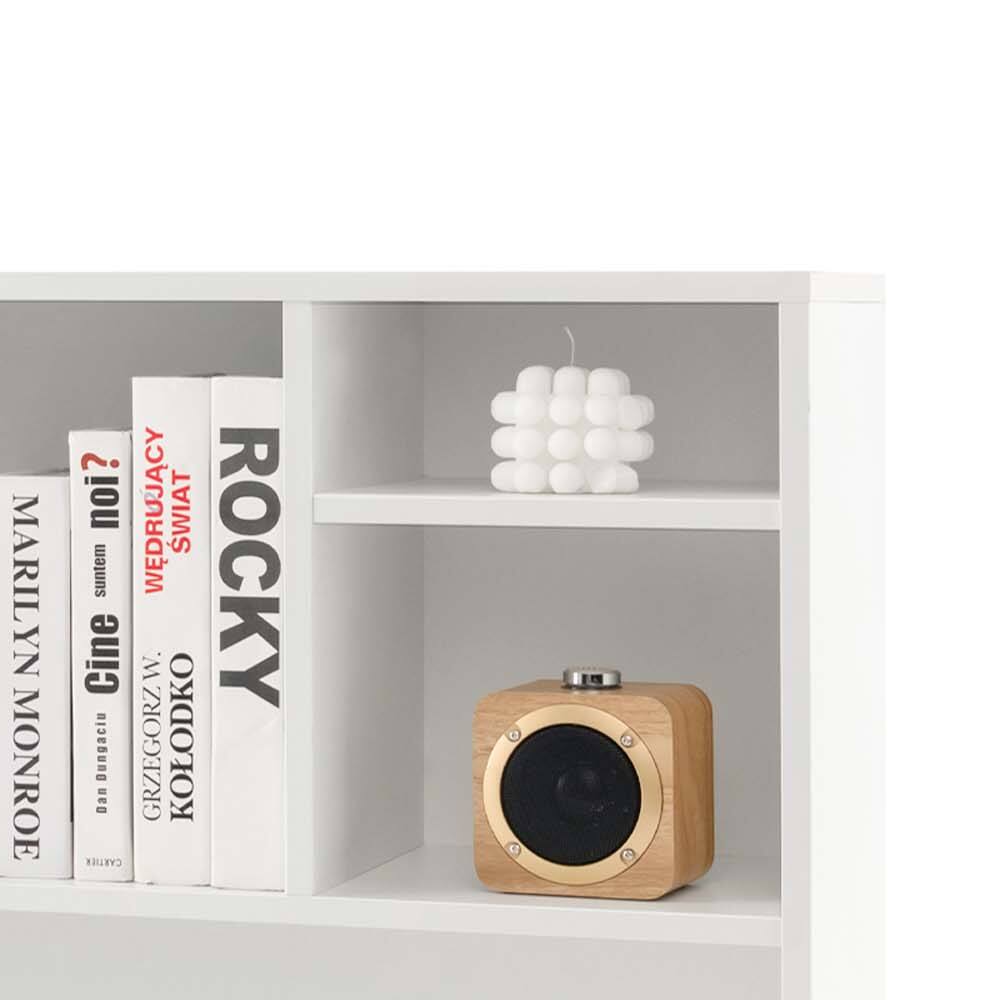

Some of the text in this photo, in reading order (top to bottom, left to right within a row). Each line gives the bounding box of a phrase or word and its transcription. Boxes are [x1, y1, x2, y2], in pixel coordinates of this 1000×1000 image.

[93, 544, 107, 598] suntem
[145, 426, 169, 594] WĘDRUJĄCY
[166, 469, 191, 554] ŚWIAT
[219, 427, 282, 709] ROCKY
[12, 495, 41, 861] MARILYN MONROE
[84, 614, 120, 694] Cine
[95, 712, 108, 814] Dan Dungaciu
[142, 652, 162, 822] GRZEGORZ W.
[169, 652, 195, 822] KOŁODKO
[86, 858, 122, 868] CARTIER
